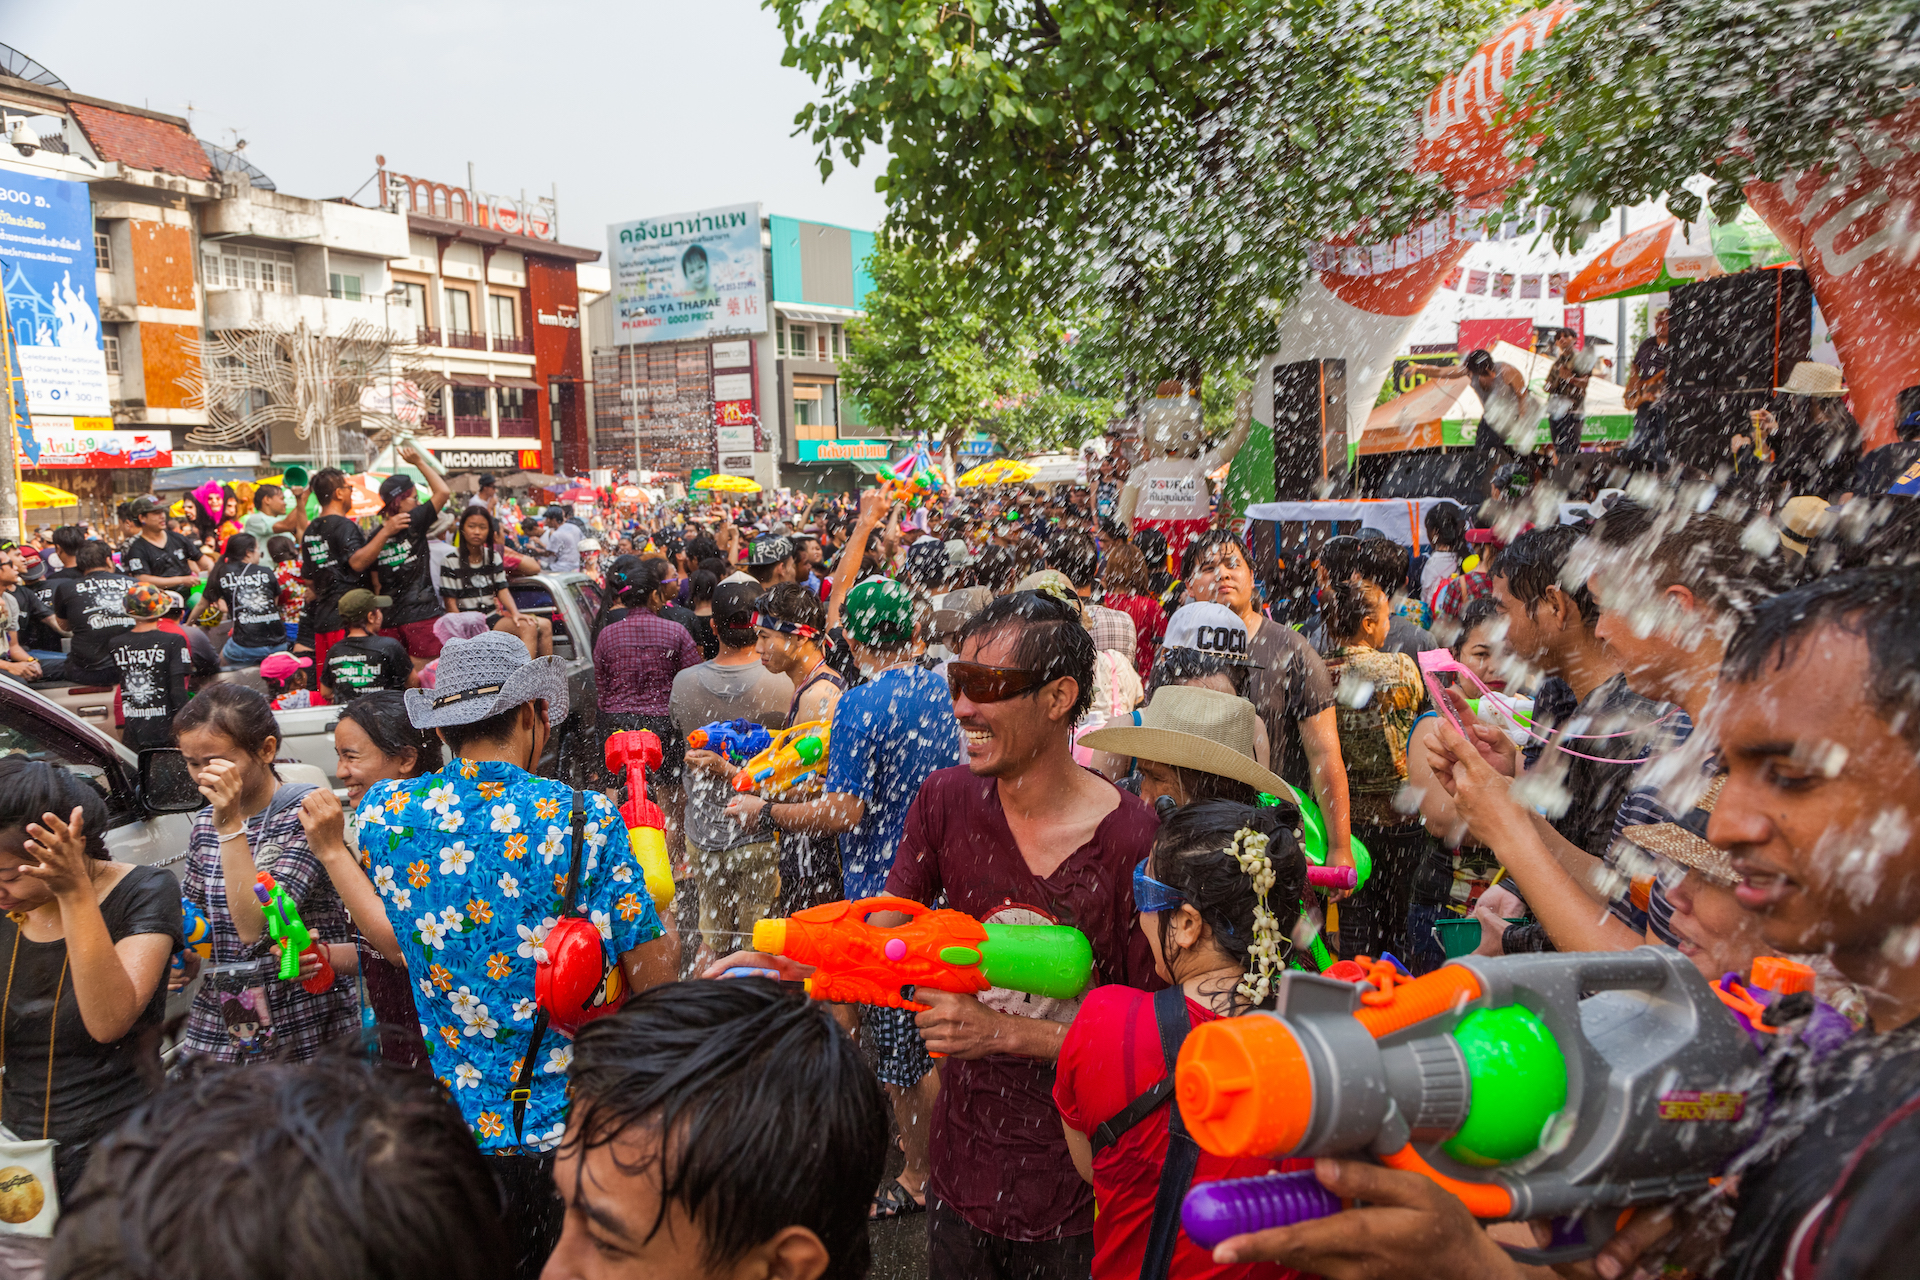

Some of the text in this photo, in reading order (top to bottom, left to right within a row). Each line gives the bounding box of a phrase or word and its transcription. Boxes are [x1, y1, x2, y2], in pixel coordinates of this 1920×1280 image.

[619, 211, 747, 243] คลังยาท่าแพ
[621, 297, 721, 317] KLNG YA THAPAE
[668, 314, 689, 325] GOOD
[691, 311, 714, 323] PRICE
[75, 393, 92, 402] 300
[82, 420, 104, 429] OPEN
[78, 437, 95, 451] 59
[441, 451, 515, 468] McDonald's
[220, 571, 270, 589] always
[1197, 625, 1246, 654] COCO
